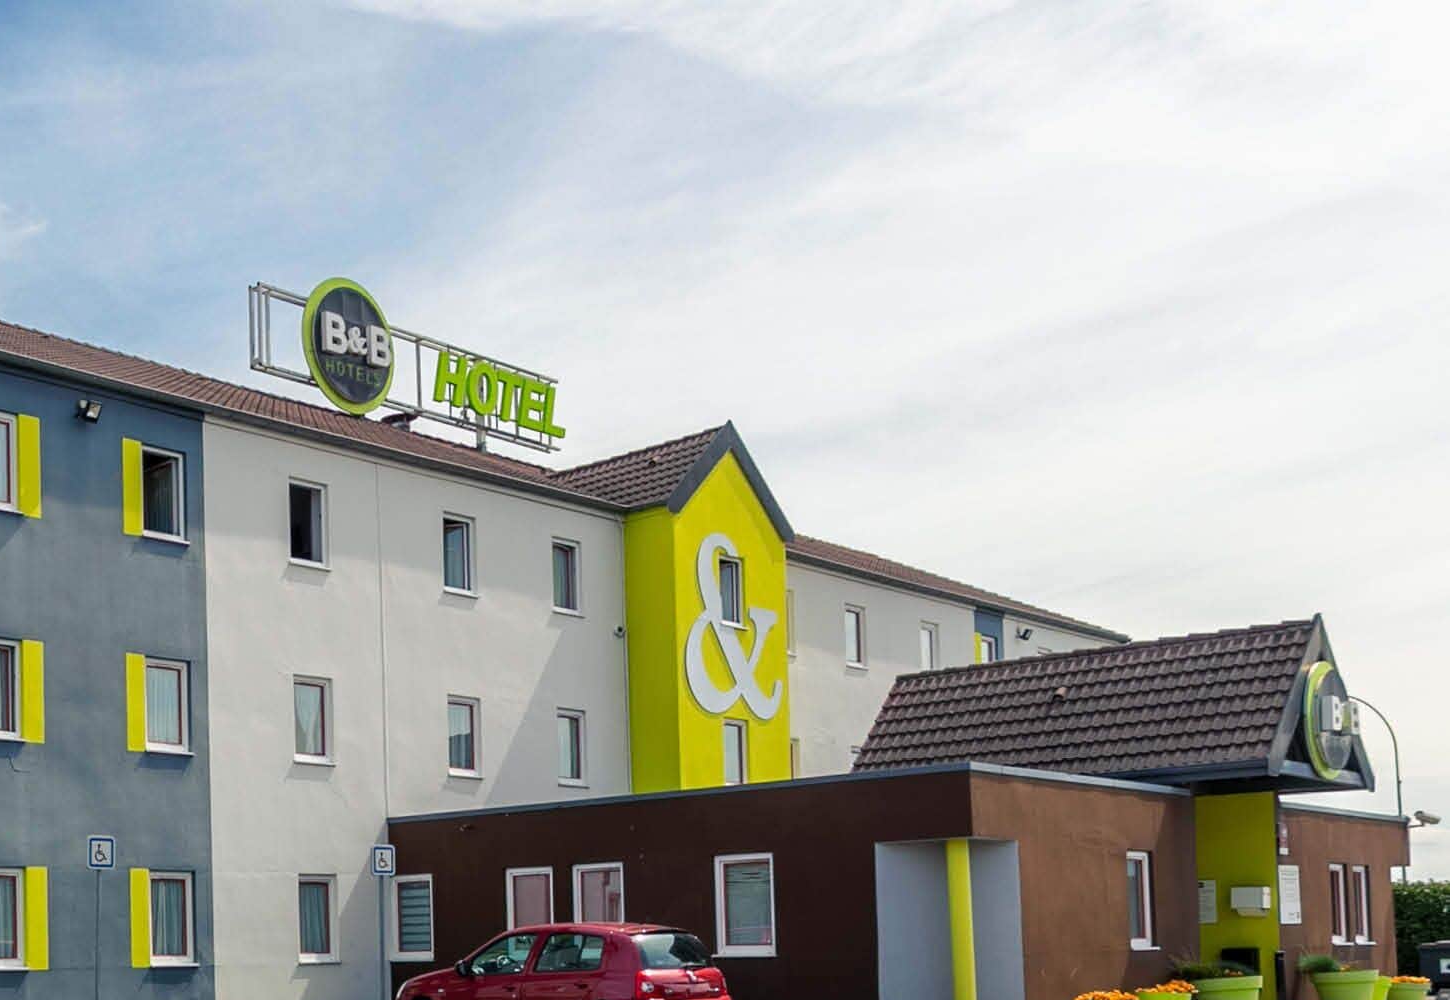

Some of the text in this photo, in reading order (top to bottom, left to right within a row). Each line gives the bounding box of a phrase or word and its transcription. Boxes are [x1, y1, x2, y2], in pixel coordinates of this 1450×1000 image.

[321, 311, 391, 368] B&B
[325, 359, 382, 387] HOTELS
[433, 350, 566, 438] HOTEL
[685, 532, 782, 720] &
[1321, 696, 1360, 735] BB
